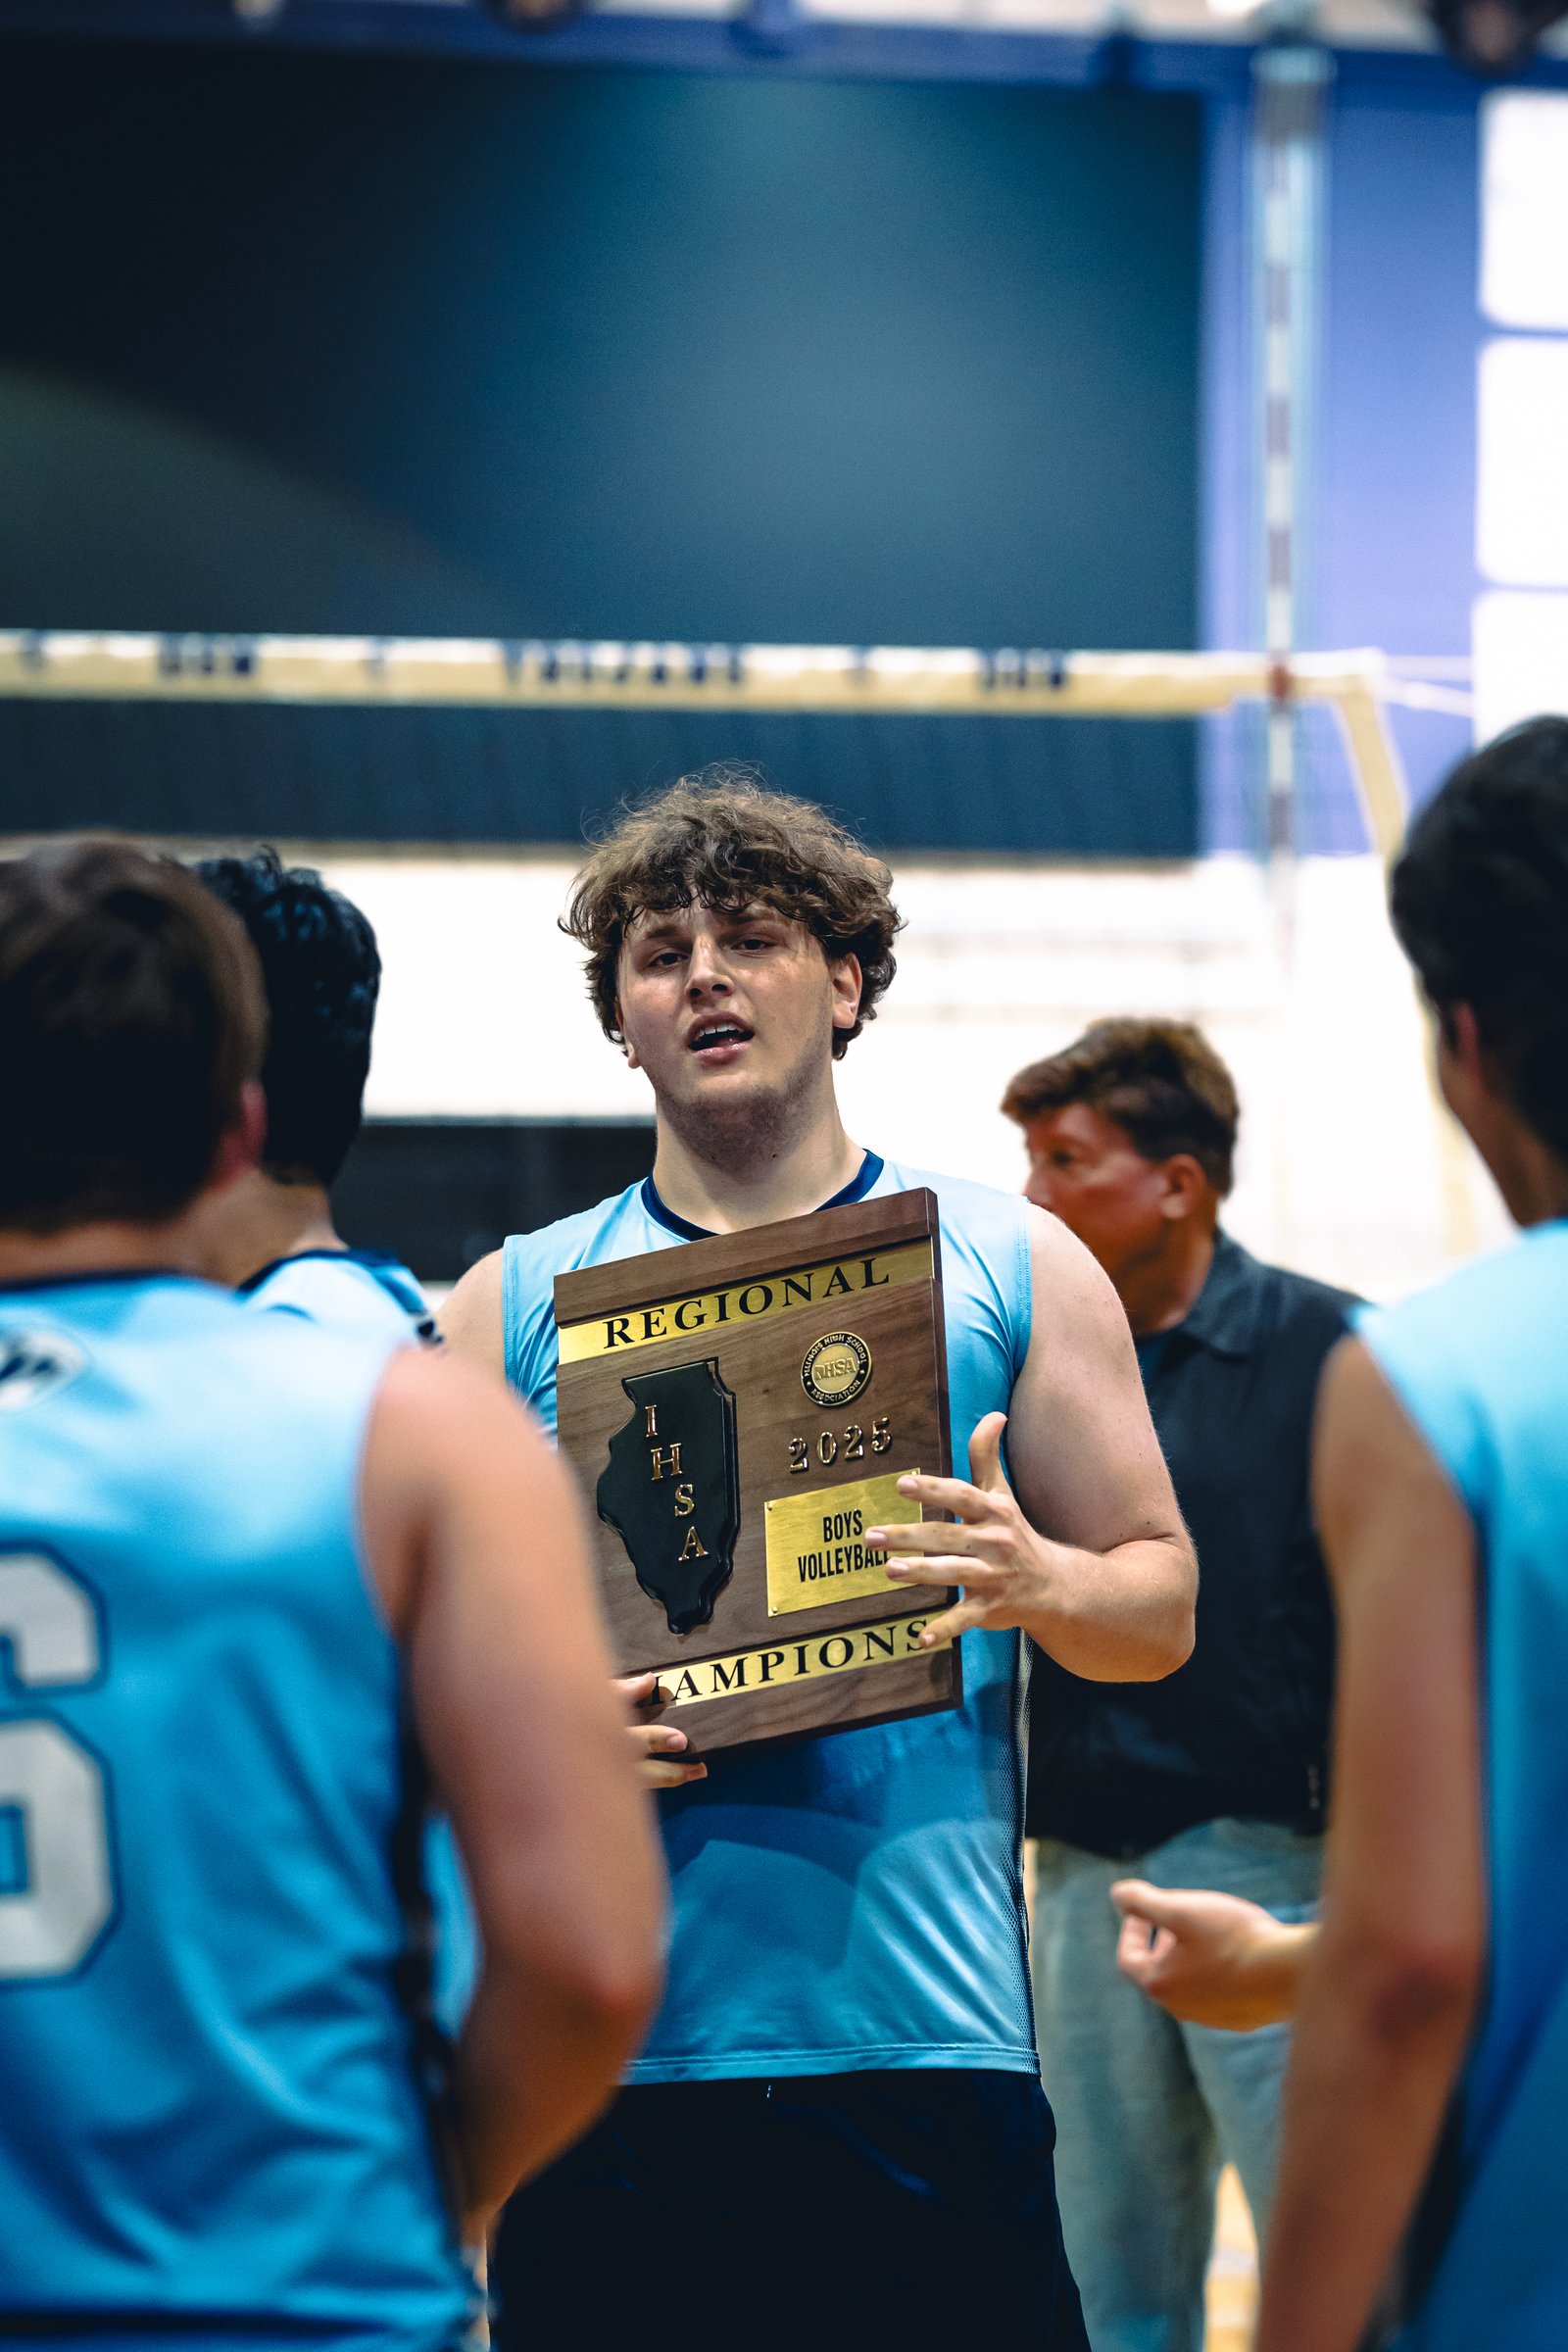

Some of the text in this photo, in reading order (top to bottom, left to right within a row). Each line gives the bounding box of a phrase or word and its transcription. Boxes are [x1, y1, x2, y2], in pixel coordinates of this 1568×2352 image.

[603, 1257, 889, 1349] REGIONAL
[823, 1334, 845, 1346] HIGH
[846, 1336, 867, 1364] SCHOOL
[810, 1379, 861, 1401] ASSOCIATION
[788, 1417, 892, 1473] 2025
[822, 1509, 863, 1543] BOYS
